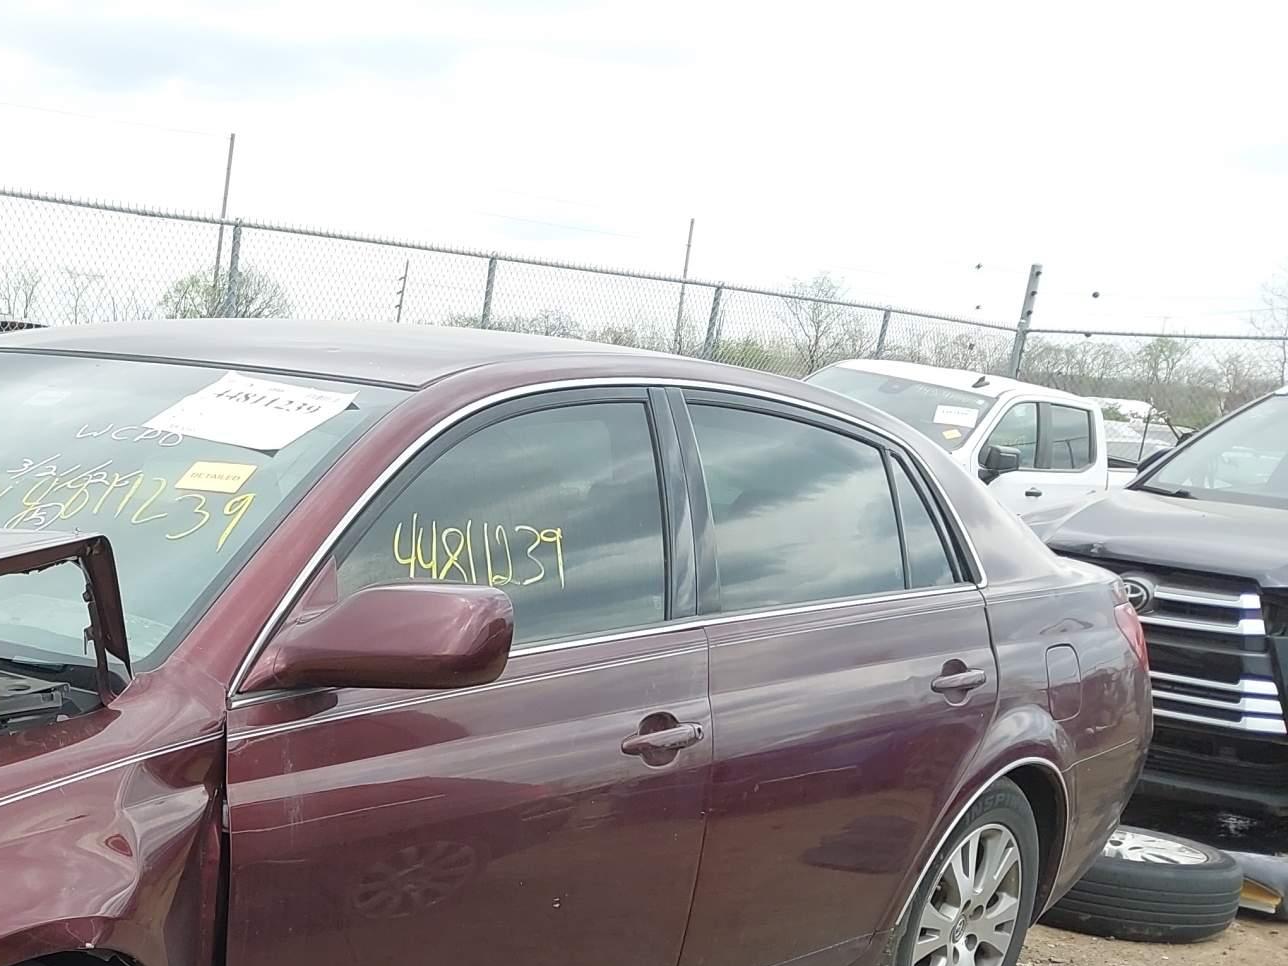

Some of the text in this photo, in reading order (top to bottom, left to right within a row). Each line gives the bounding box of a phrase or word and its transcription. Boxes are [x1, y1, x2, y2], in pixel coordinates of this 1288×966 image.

[214, 388, 323, 414] 44811239
[189, 471, 243, 483] DETAILED
[393, 512, 566, 590] 44811239
